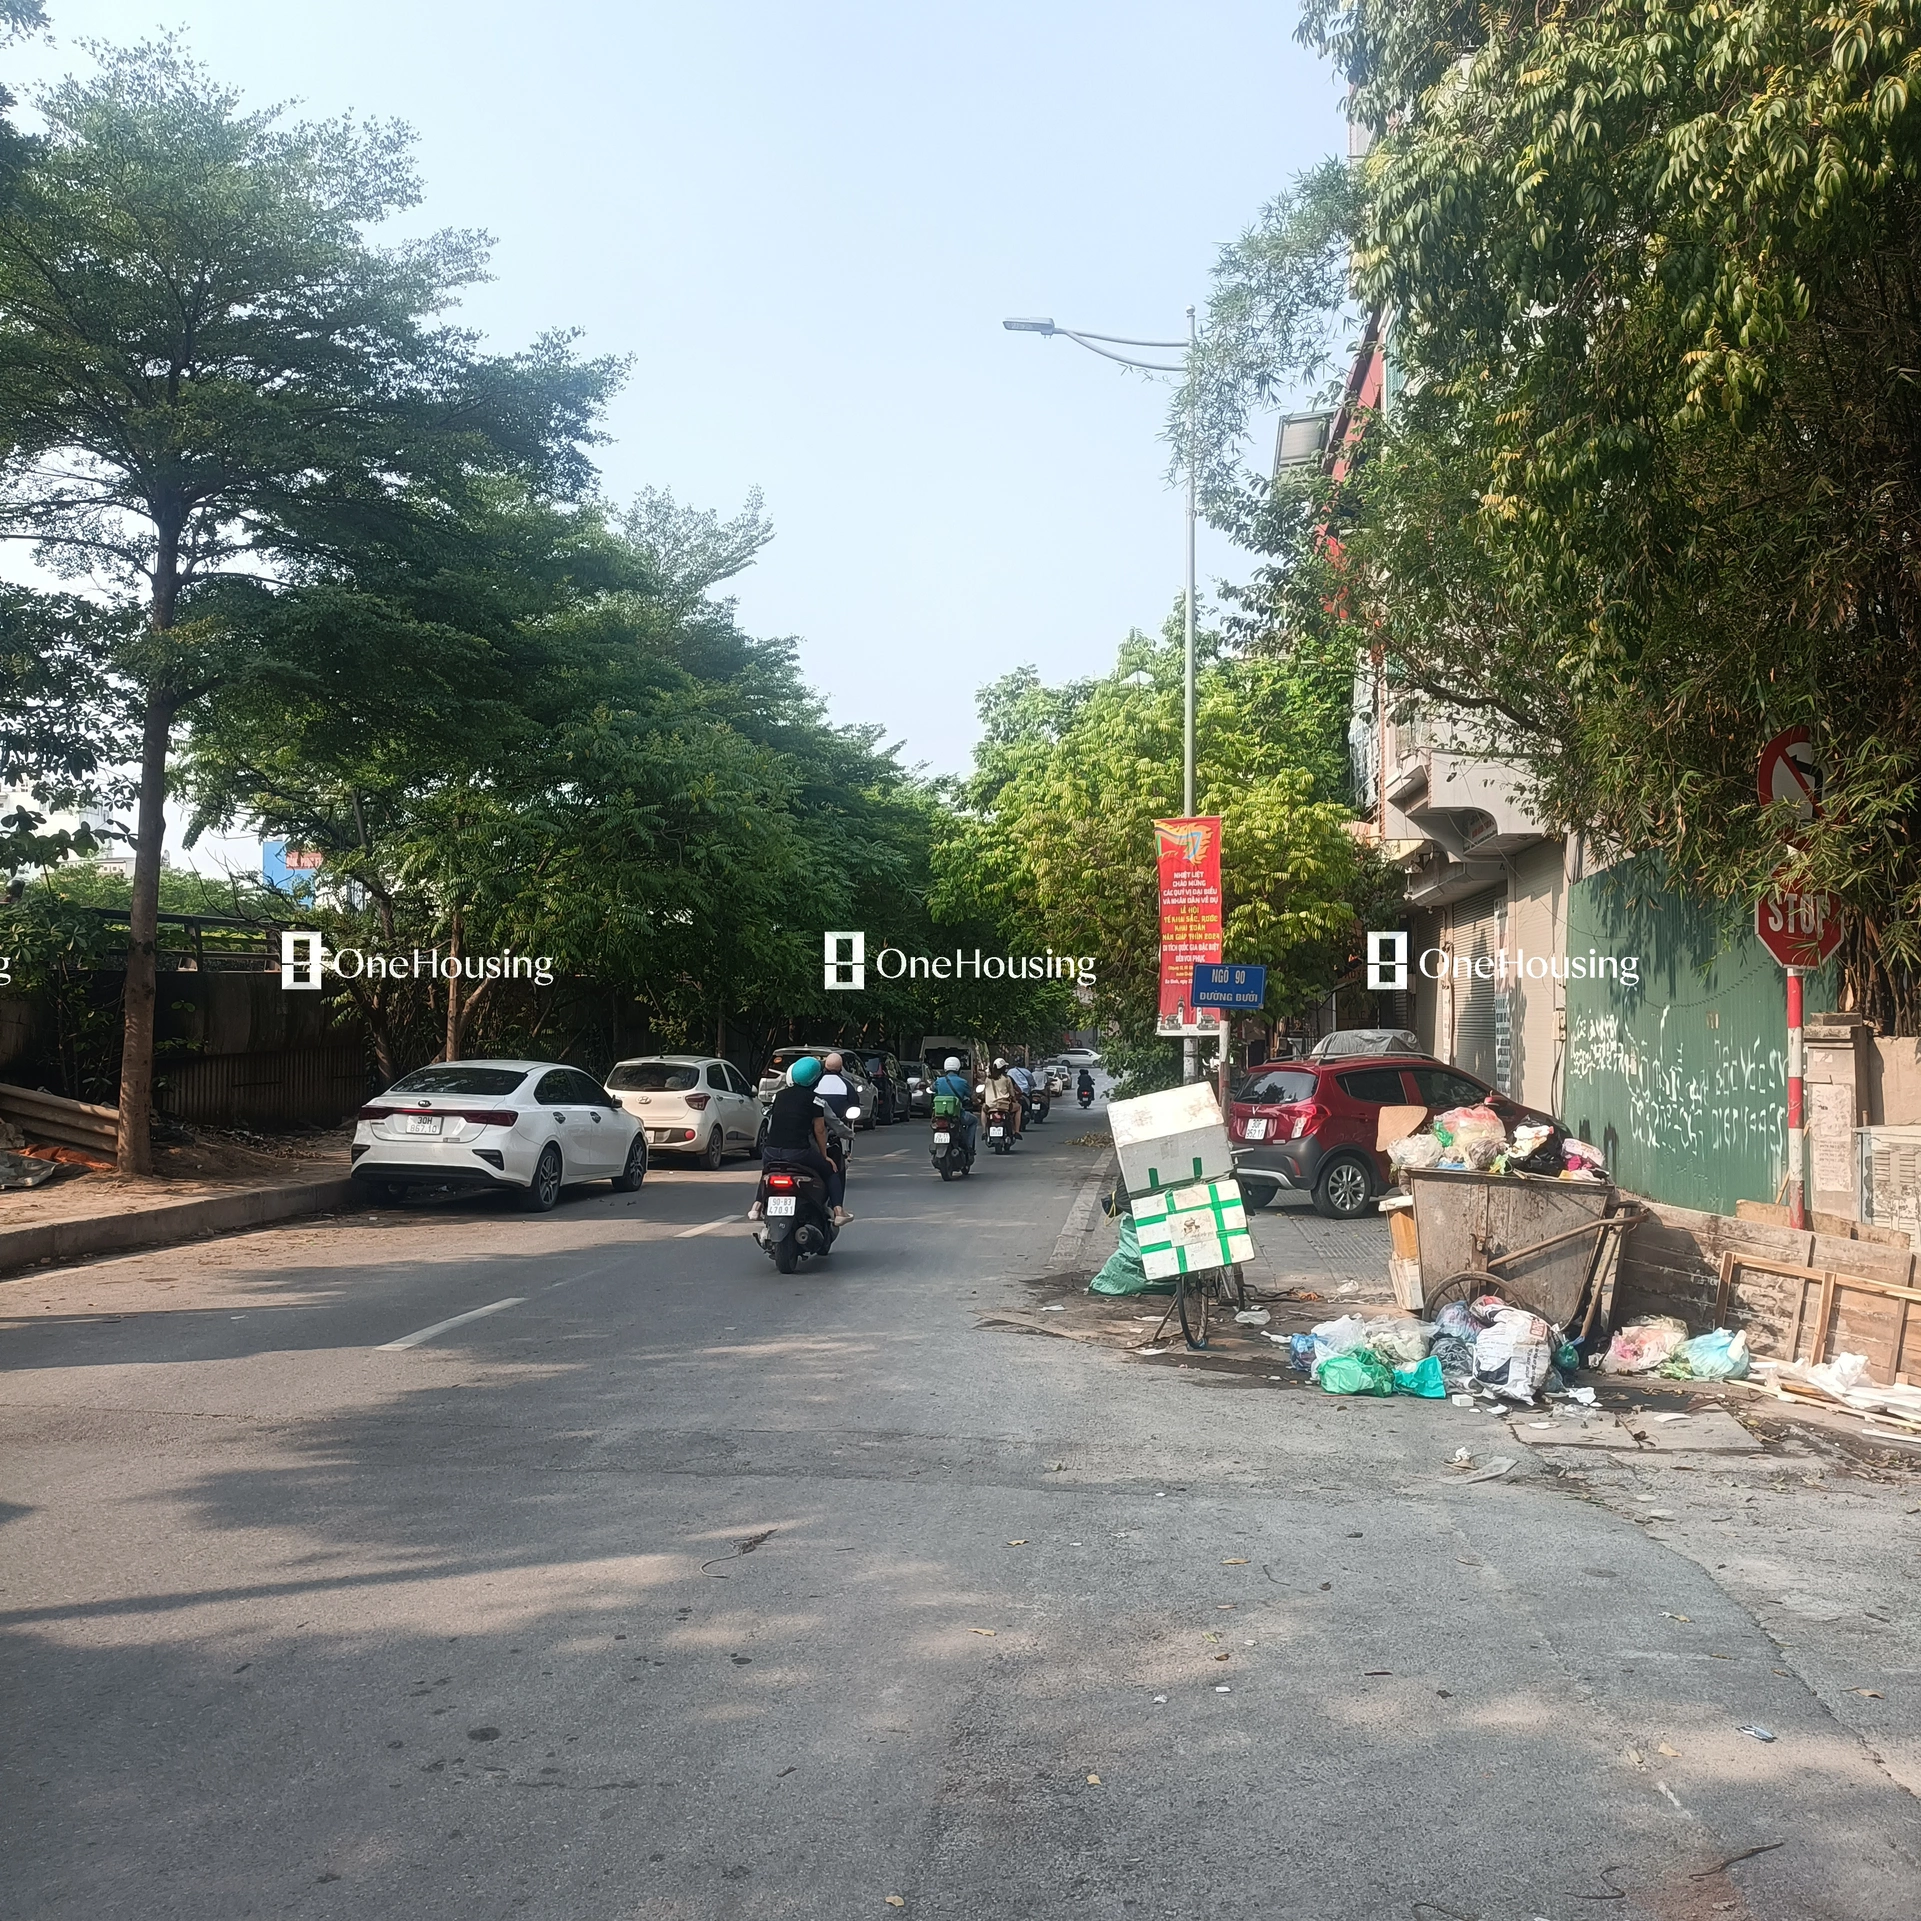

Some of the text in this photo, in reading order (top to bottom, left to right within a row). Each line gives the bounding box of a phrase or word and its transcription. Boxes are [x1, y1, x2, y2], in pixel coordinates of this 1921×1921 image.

[1768, 890, 1831, 934] STOP
[1204, 932, 1220, 940] 2024
[1211, 966, 1246, 985] NGÕ 90
[1199, 989, 1233, 1002] ĐƯỜNG
[417, 1116, 433, 1125] 30H
